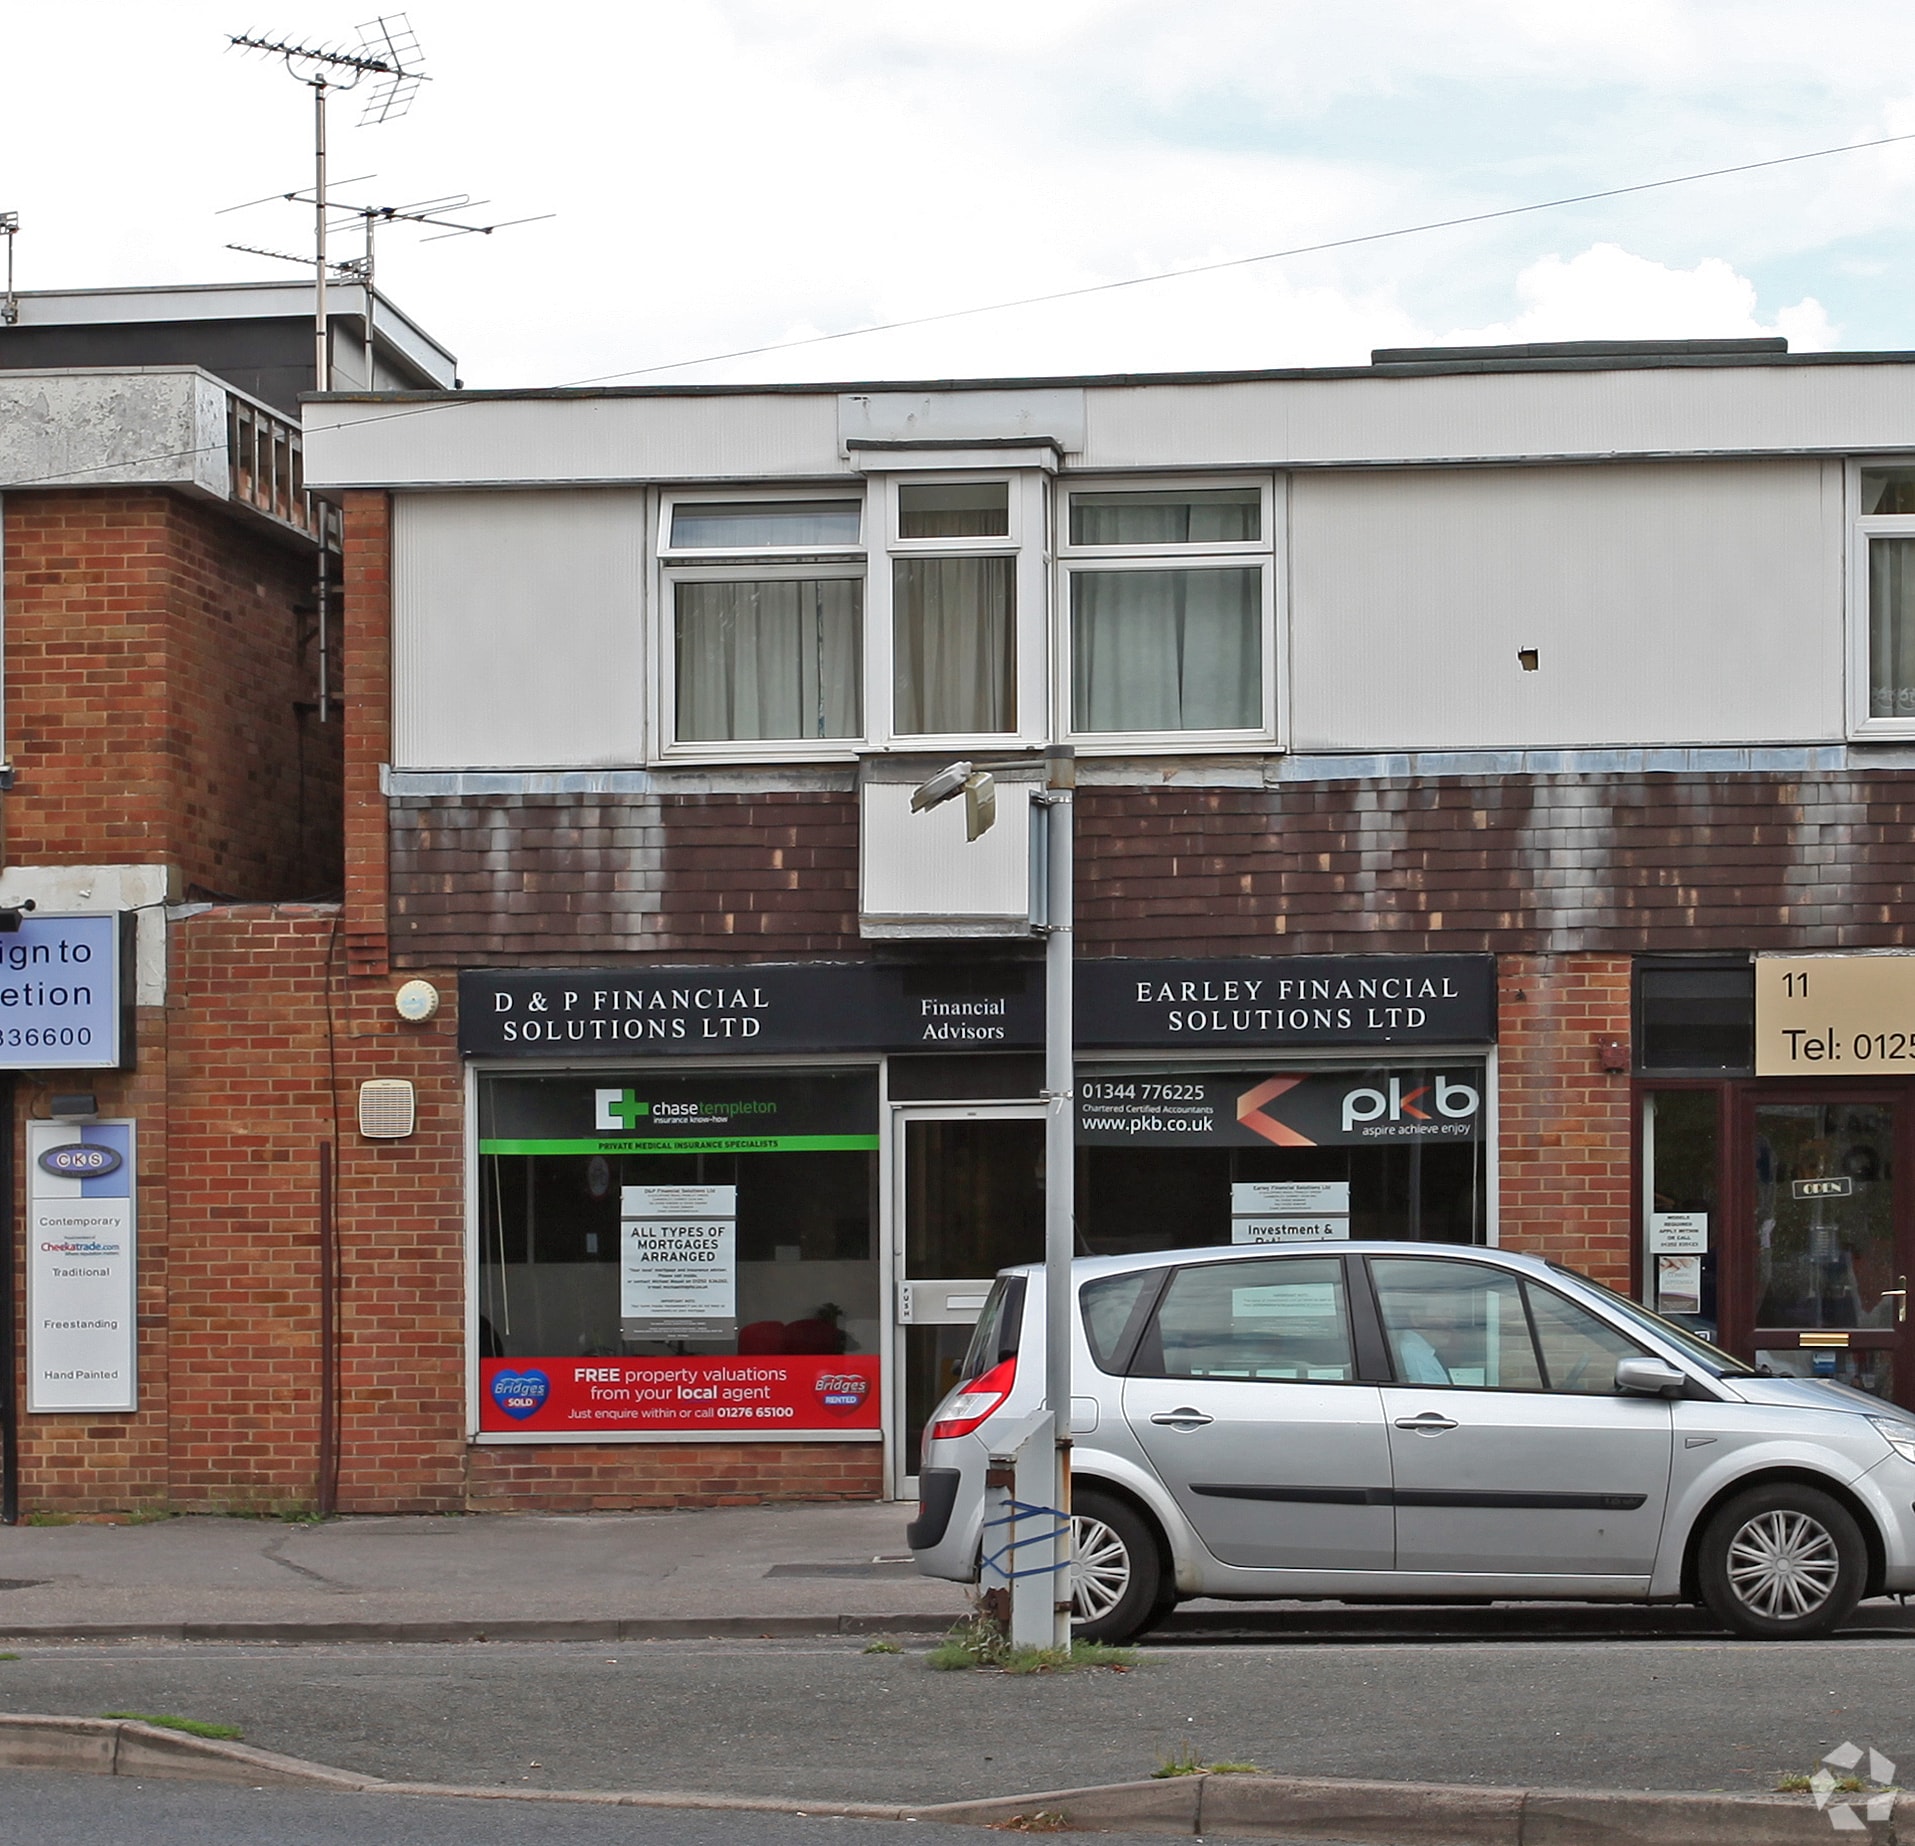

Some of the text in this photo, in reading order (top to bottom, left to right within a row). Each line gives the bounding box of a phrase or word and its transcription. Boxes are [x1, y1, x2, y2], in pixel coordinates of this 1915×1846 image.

[59, 940, 91, 963] to
[1136, 978, 1458, 1002] EARLEY FINANCIAL
[1782, 972, 1807, 997] 11
[1, 982, 91, 1006] etion
[494, 988, 769, 1012] D & P FINANCIAL
[921, 999, 1005, 1016] Financial
[1168, 1007, 1426, 1031] SOLUTIONS LTD
[503, 1017, 760, 1041] SOLUTIONS LTD
[922, 1022, 1004, 1039] Advisors
[1782, 1027, 1841, 1060] Tel:
[1082, 1083, 1205, 1100] 01344 776225
[1082, 1103, 1214, 1114] Chartered Certified Accountants
[1342, 1075, 1479, 1131] pkb
[653, 1115, 728, 1124] insurance know-how
[1082, 1115, 1213, 1135] www.pkb.co.uk
[1362, 1123, 1471, 1137] aspire achieve enjoy
[599, 1140, 778, 1150] PRIVATE MEDICAL INSURANCE SPECIALISTS
[58, 1153, 101, 1167] CKS
[1803, 1183, 1842, 1195] OPEN
[40, 1217, 120, 1227] Contemporary
[1248, 1223, 1333, 1235] Investment &
[631, 1226, 726, 1238] ALL TYPES OF
[637, 1239, 719, 1250] MORTGAGES
[641, 1252, 716, 1262] ARRANGED
[53, 1267, 110, 1277] Traditional
[44, 1319, 118, 1330] Freestanding
[44, 1369, 118, 1380] Hand Painted
[574, 1367, 787, 1384] FREE property valuations
[494, 1382, 545, 1397] Bridges
[815, 1379, 866, 1394] Bridges
[591, 1385, 771, 1403] from your local agent
[825, 1396, 857, 1404] RENTED
[508, 1398, 534, 1407] SOLD
[568, 1406, 794, 1420] Just enquire within or call 01276 65100
